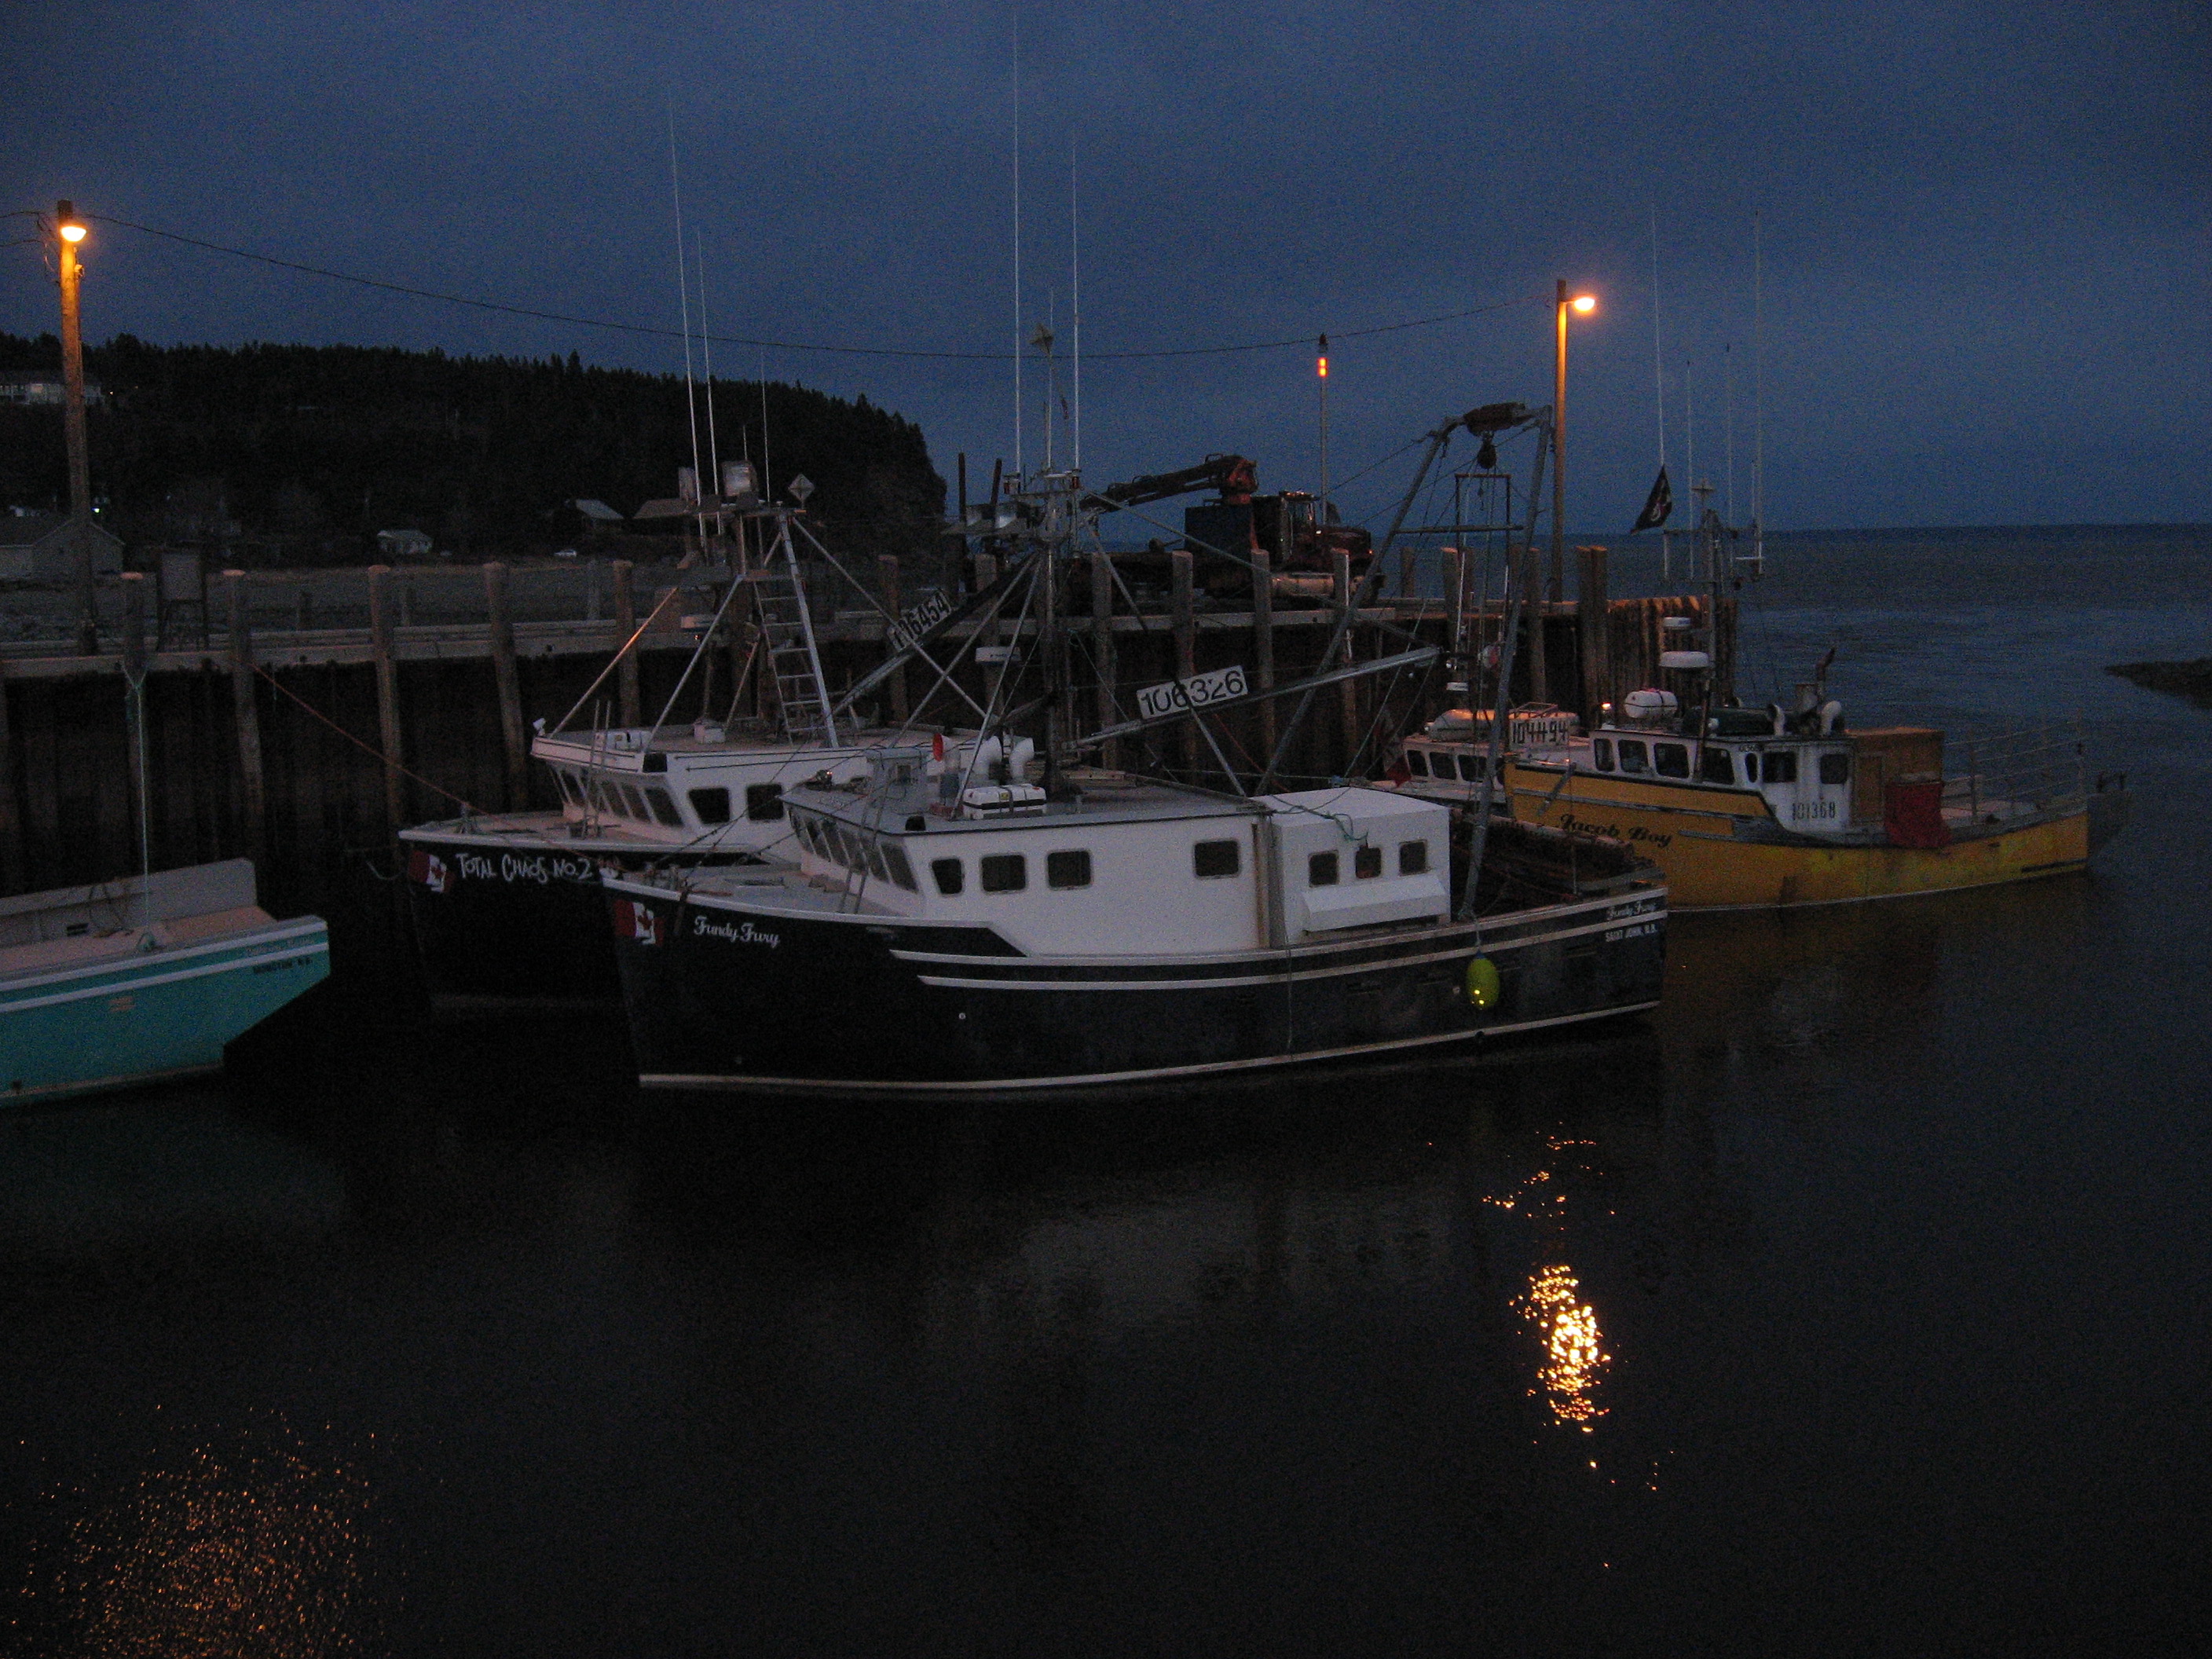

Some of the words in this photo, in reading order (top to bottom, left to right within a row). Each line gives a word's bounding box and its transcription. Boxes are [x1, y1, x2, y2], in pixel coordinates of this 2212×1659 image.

[1141, 671, 1243, 715] 106326
[1513, 720, 1568, 743] 104494
[1793, 801, 1836, 820] 101368
[1560, 814, 1620, 837] Jacob
[1628, 827, 1673, 848] Boy
[693, 915, 738, 943] Fundy
[739, 922, 781, 949] Fury
